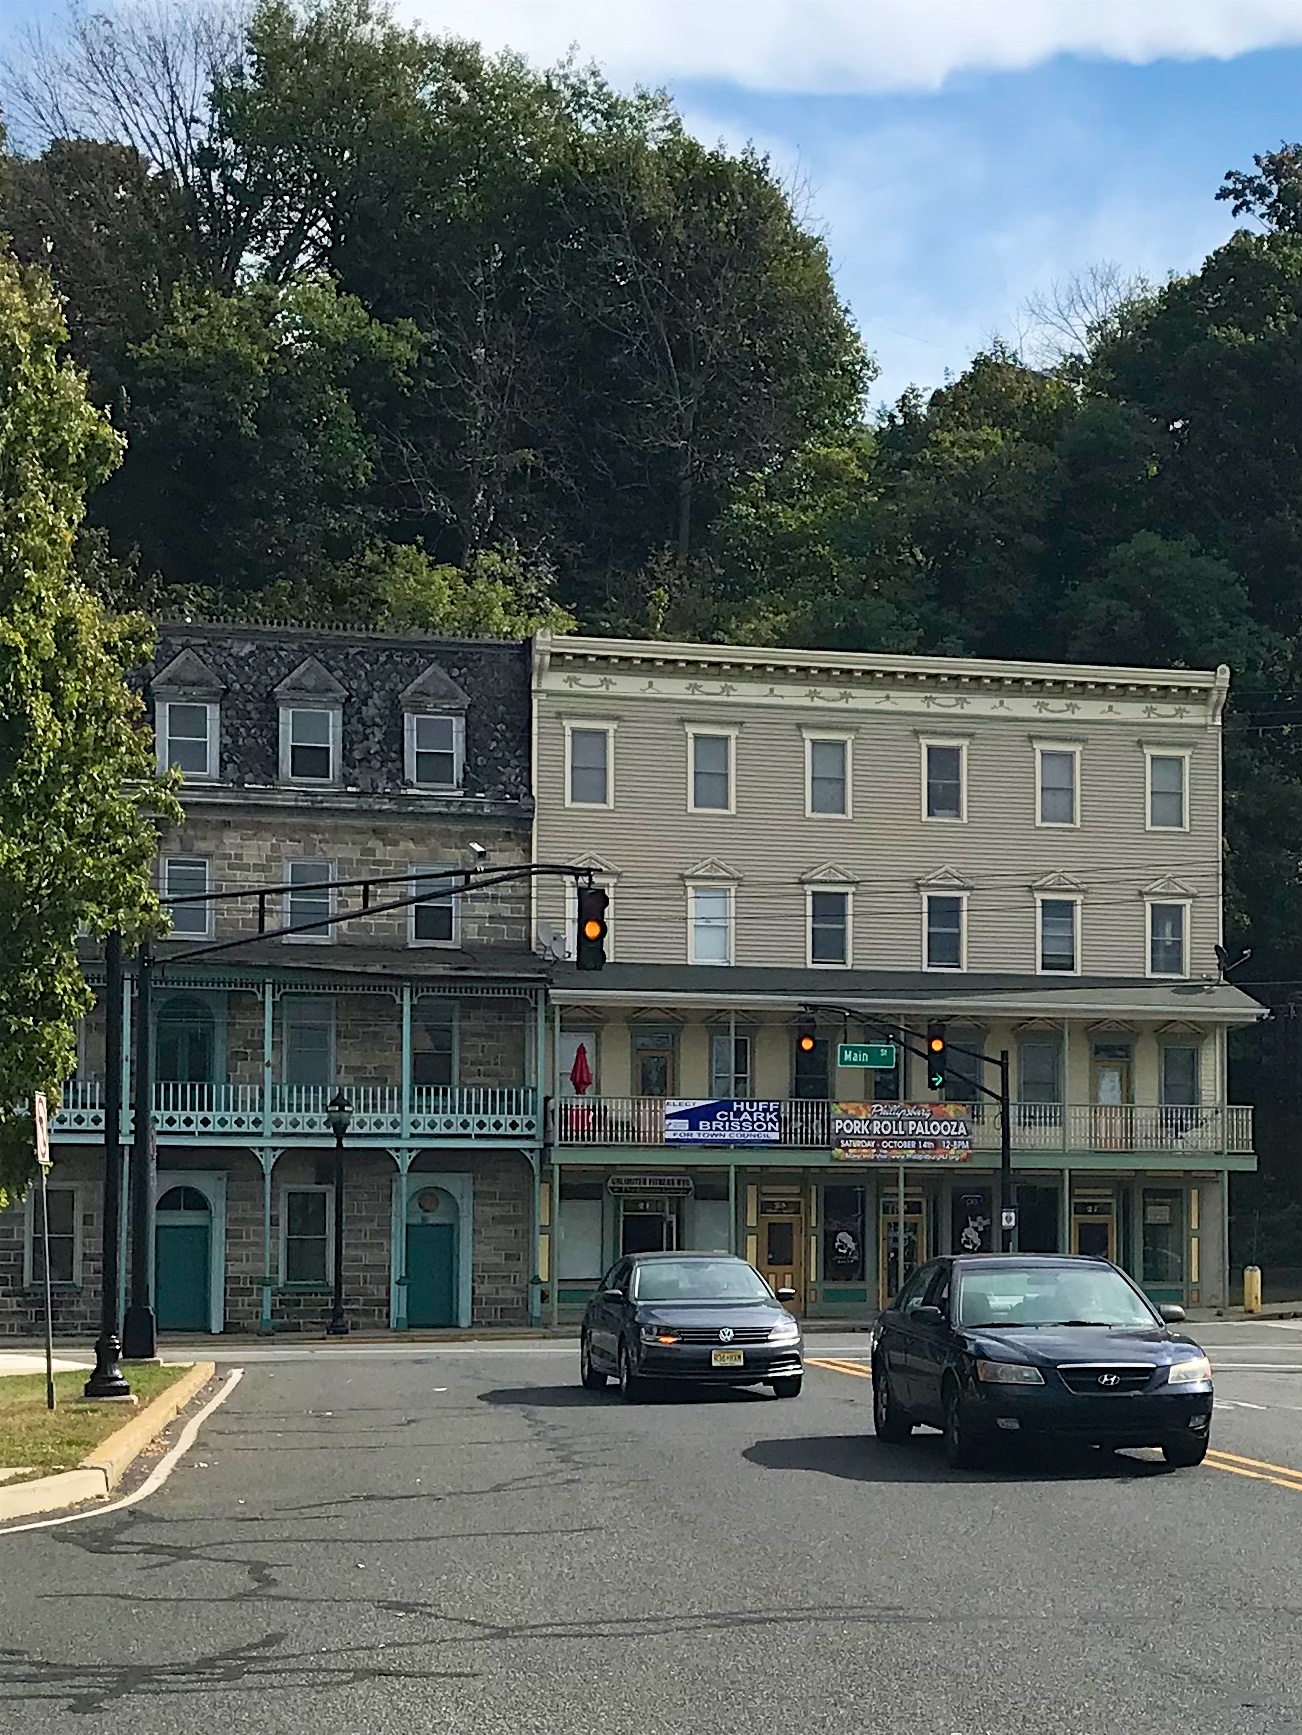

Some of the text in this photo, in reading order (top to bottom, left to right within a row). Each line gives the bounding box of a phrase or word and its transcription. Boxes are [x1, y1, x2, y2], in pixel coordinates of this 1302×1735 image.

[844, 1048, 888, 1062] Main St
[733, 1101, 780, 1112] HUFF
[716, 1111, 778, 1122] CLARK
[699, 1120, 780, 1132] BRISSON
[835, 1119, 968, 1137] PORK ROLL PALOOZA
[840, 1139, 876, 1148] SATURDAY
[881, 1140, 916, 1149] OCTOBER
